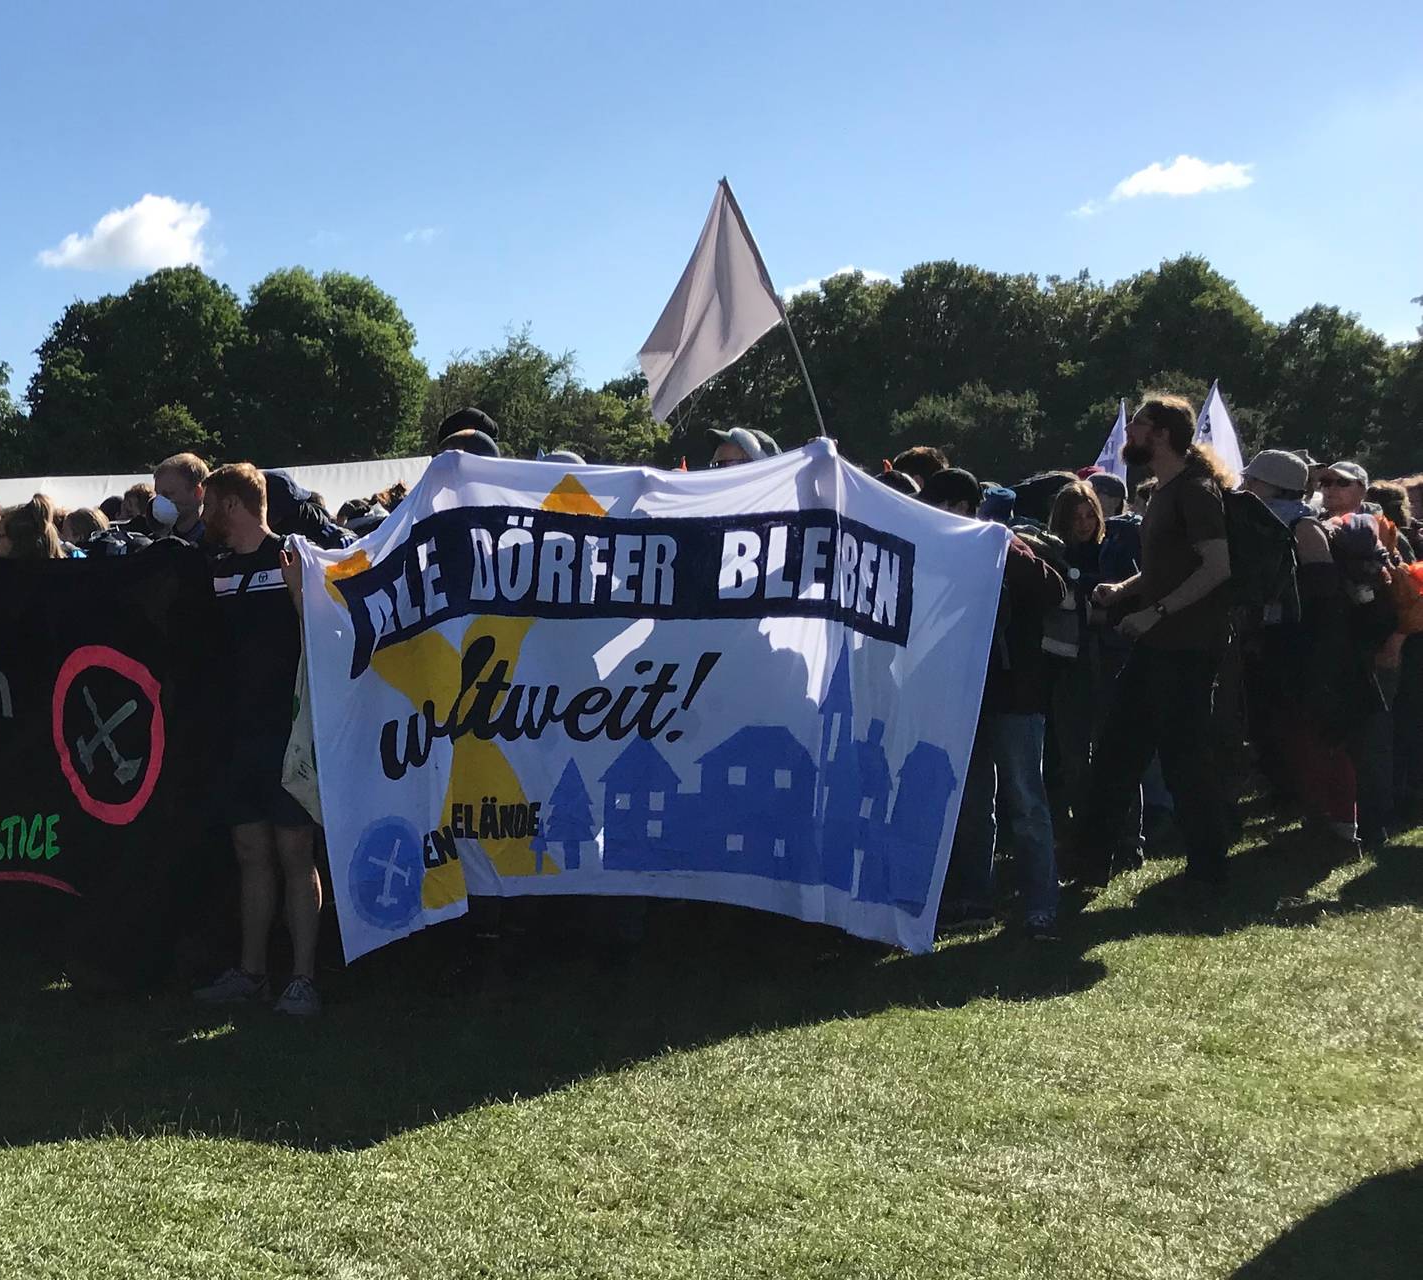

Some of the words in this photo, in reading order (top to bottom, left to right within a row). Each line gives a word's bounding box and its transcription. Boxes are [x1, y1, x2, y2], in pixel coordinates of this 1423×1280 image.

[469, 515, 677, 606] DÖRFER
[718, 525, 900, 627] BLEIBEN
[380, 635, 722, 780] wltweit!
[451, 796, 542, 840] ELÄNDE
